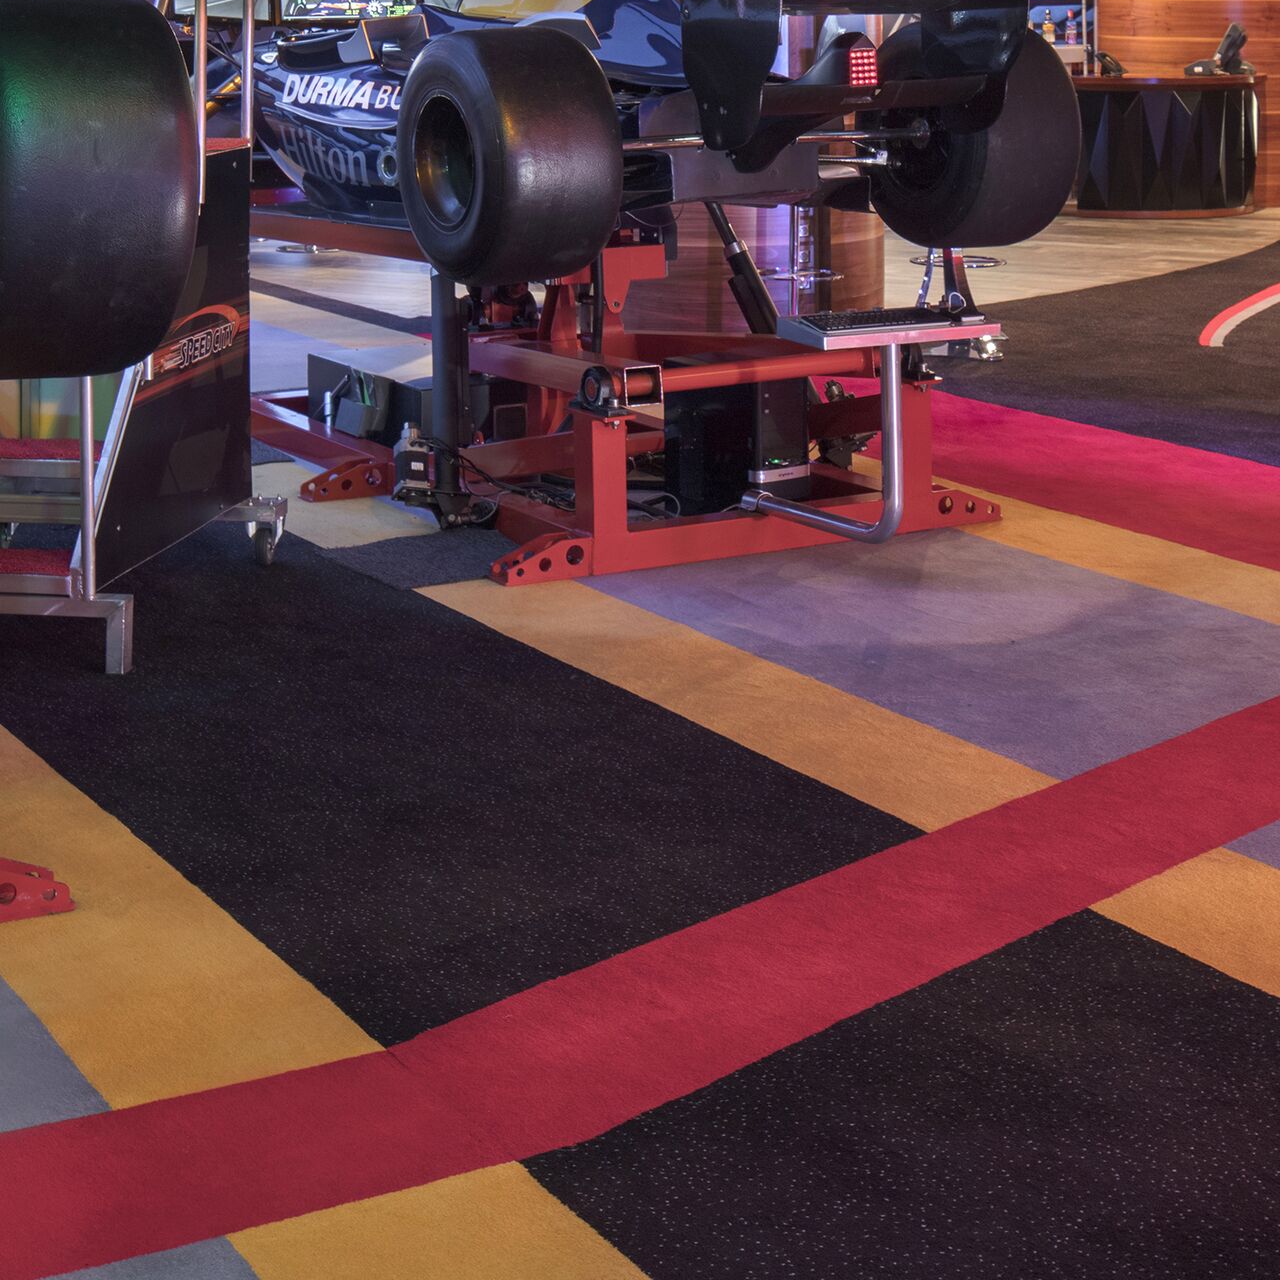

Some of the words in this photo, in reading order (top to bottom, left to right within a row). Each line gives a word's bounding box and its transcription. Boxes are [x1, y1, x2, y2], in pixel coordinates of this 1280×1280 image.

[282, 73, 375, 109] DURMA
[279, 124, 371, 188] Hilton
[178, 320, 236, 369] SPEEDCITY
